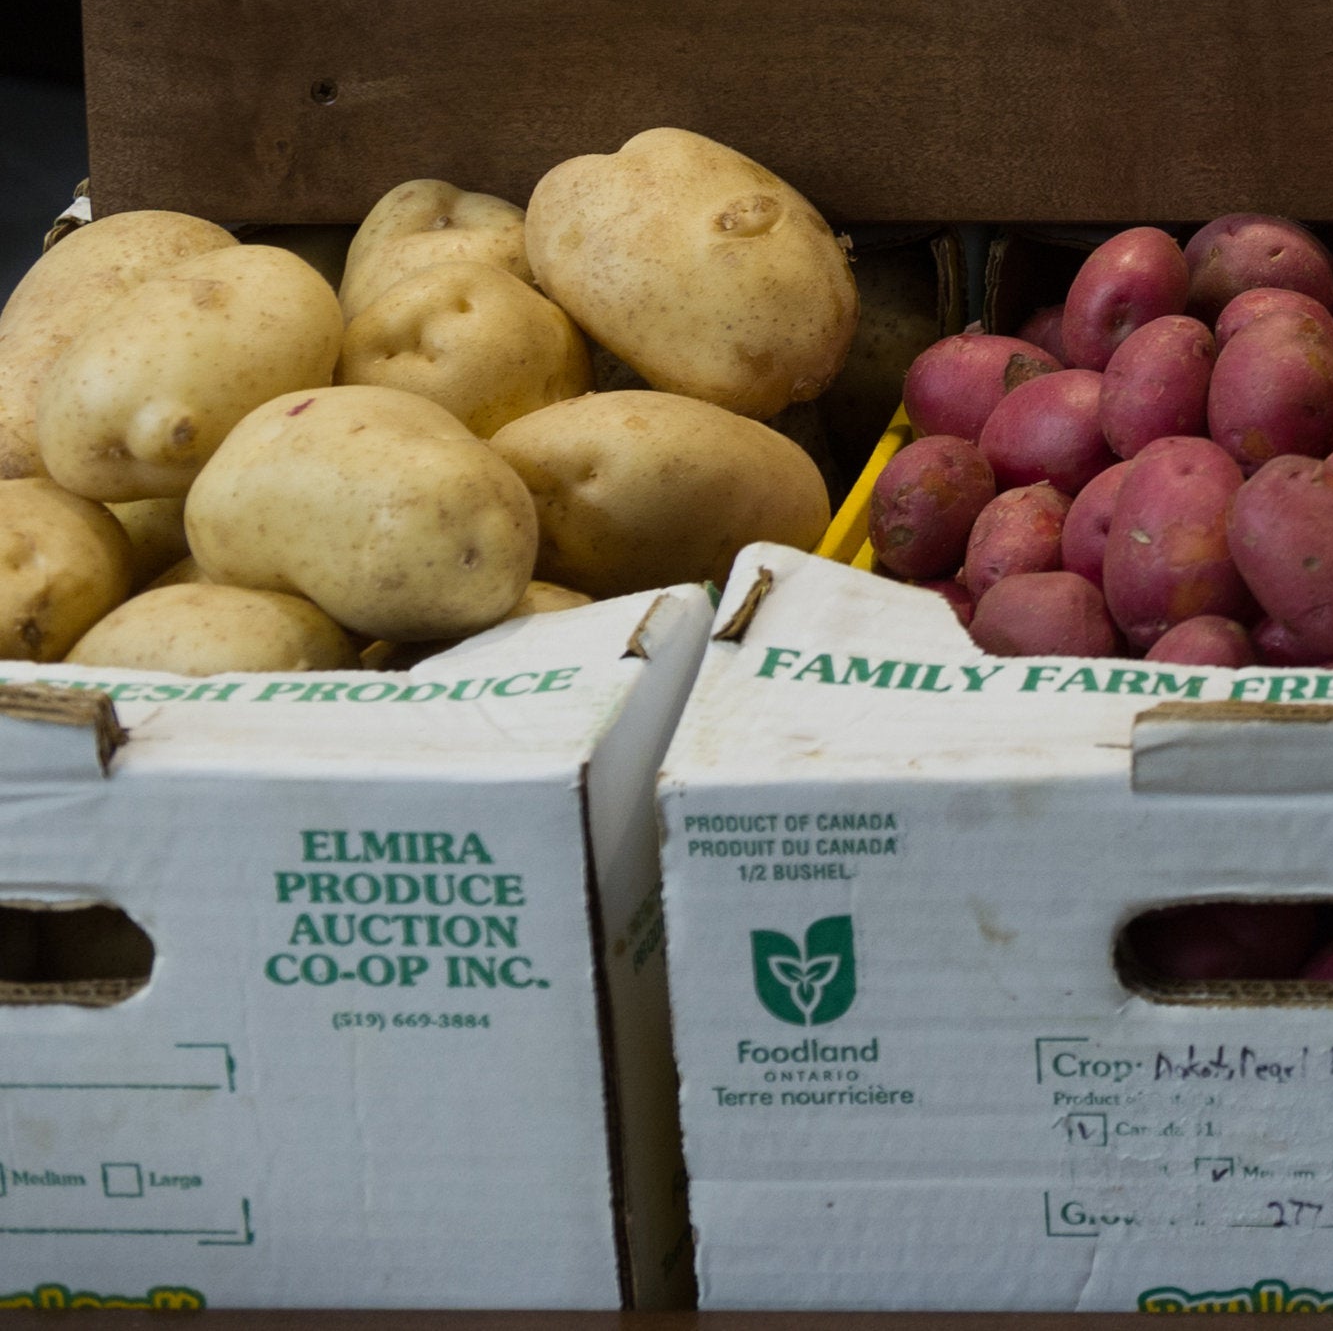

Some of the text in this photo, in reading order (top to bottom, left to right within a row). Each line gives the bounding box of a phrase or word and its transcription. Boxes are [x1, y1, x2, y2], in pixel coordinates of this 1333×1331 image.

[250, 667, 581, 702] PRODUCE
[755, 646, 1004, 693] FAMILY
[1020, 666, 1208, 699] FARM
[684, 812, 896, 833] PRODUCT CANADA
[301, 830, 494, 864] ELMIRA
[688, 837, 898, 857] PRODUIT CANADA
[738, 862, 855, 883] 1/2 BUSHEL
[275, 872, 526, 907] PRODUCE
[289, 913, 518, 948] AUCTION
[265, 953, 550, 989] CO-OP INC.
[332, 1012, 387, 1031] (519)
[737, 1038, 879, 1063] Foodland
[712, 1085, 914, 1106] Terre nourricière
[149, 1172, 203, 1190] Large
